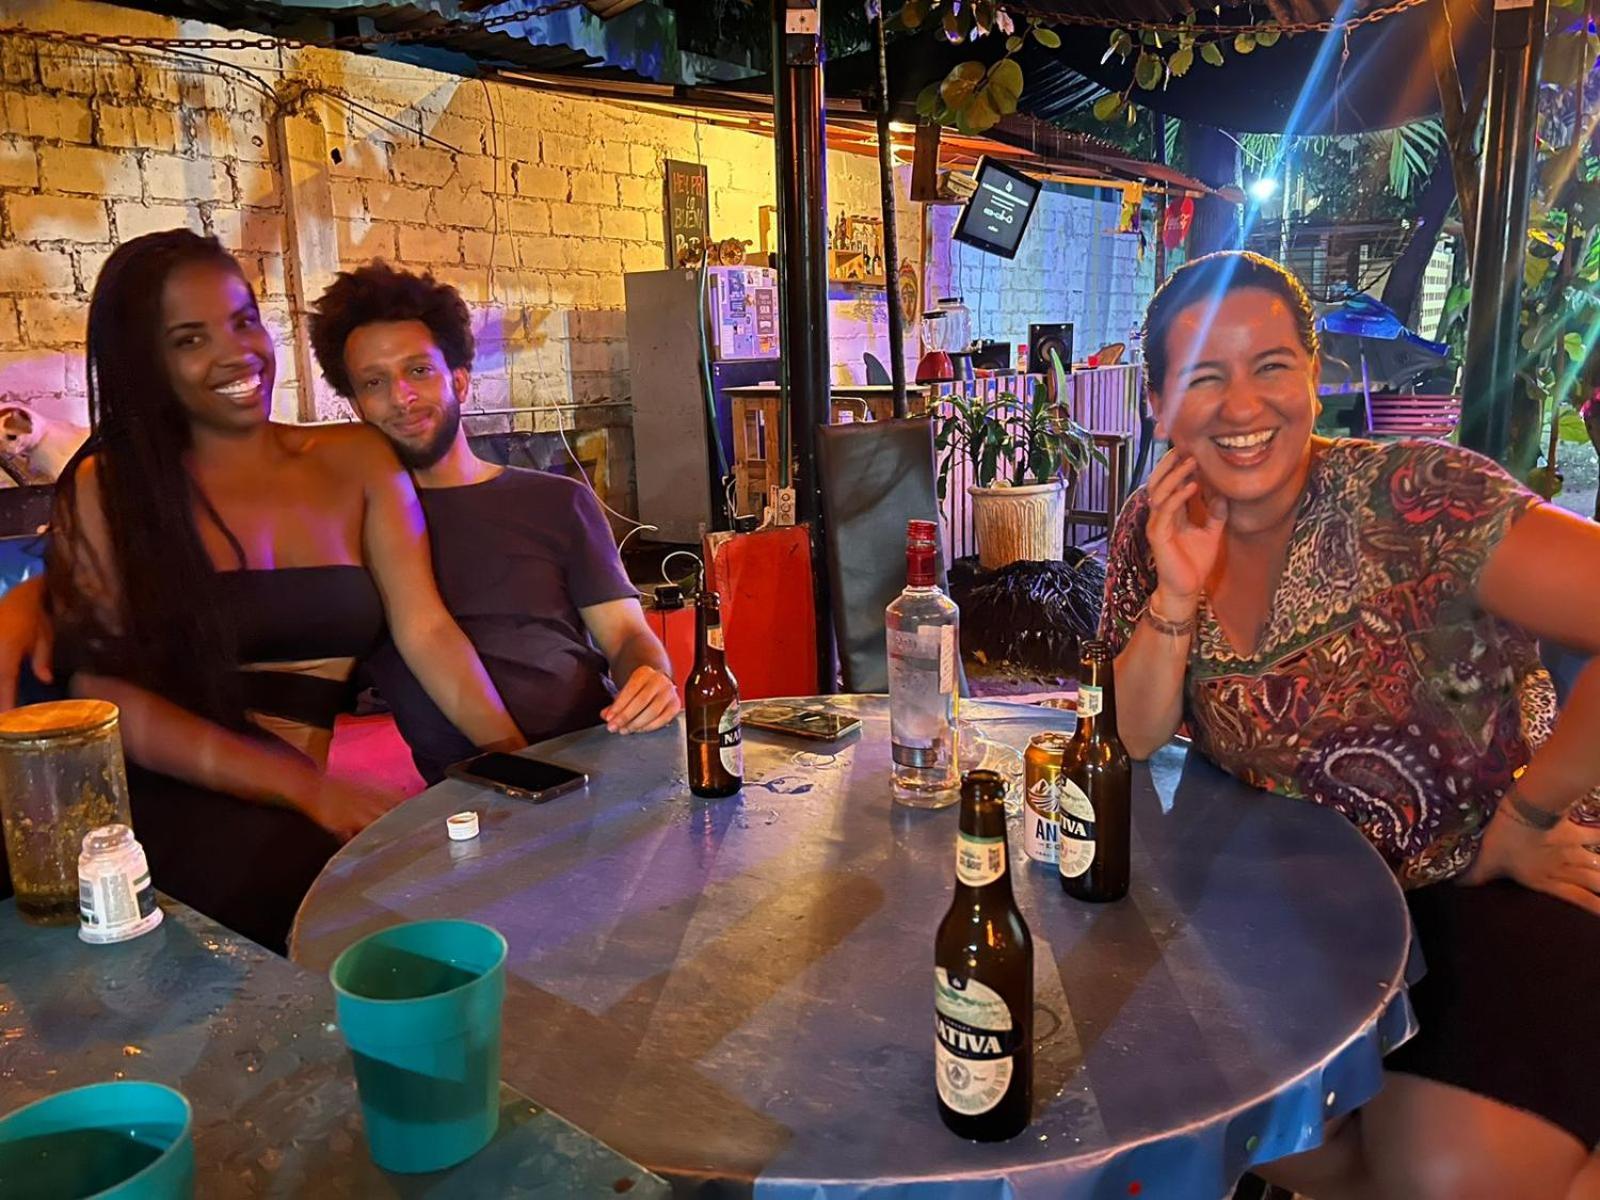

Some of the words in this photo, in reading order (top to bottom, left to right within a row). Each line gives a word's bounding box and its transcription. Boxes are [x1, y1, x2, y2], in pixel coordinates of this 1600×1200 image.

[724, 727, 742, 746] NA
[1035, 818, 1058, 843] AN
[1060, 814, 1088, 838] IVA
[937, 1018, 1003, 1055] ATIVA
